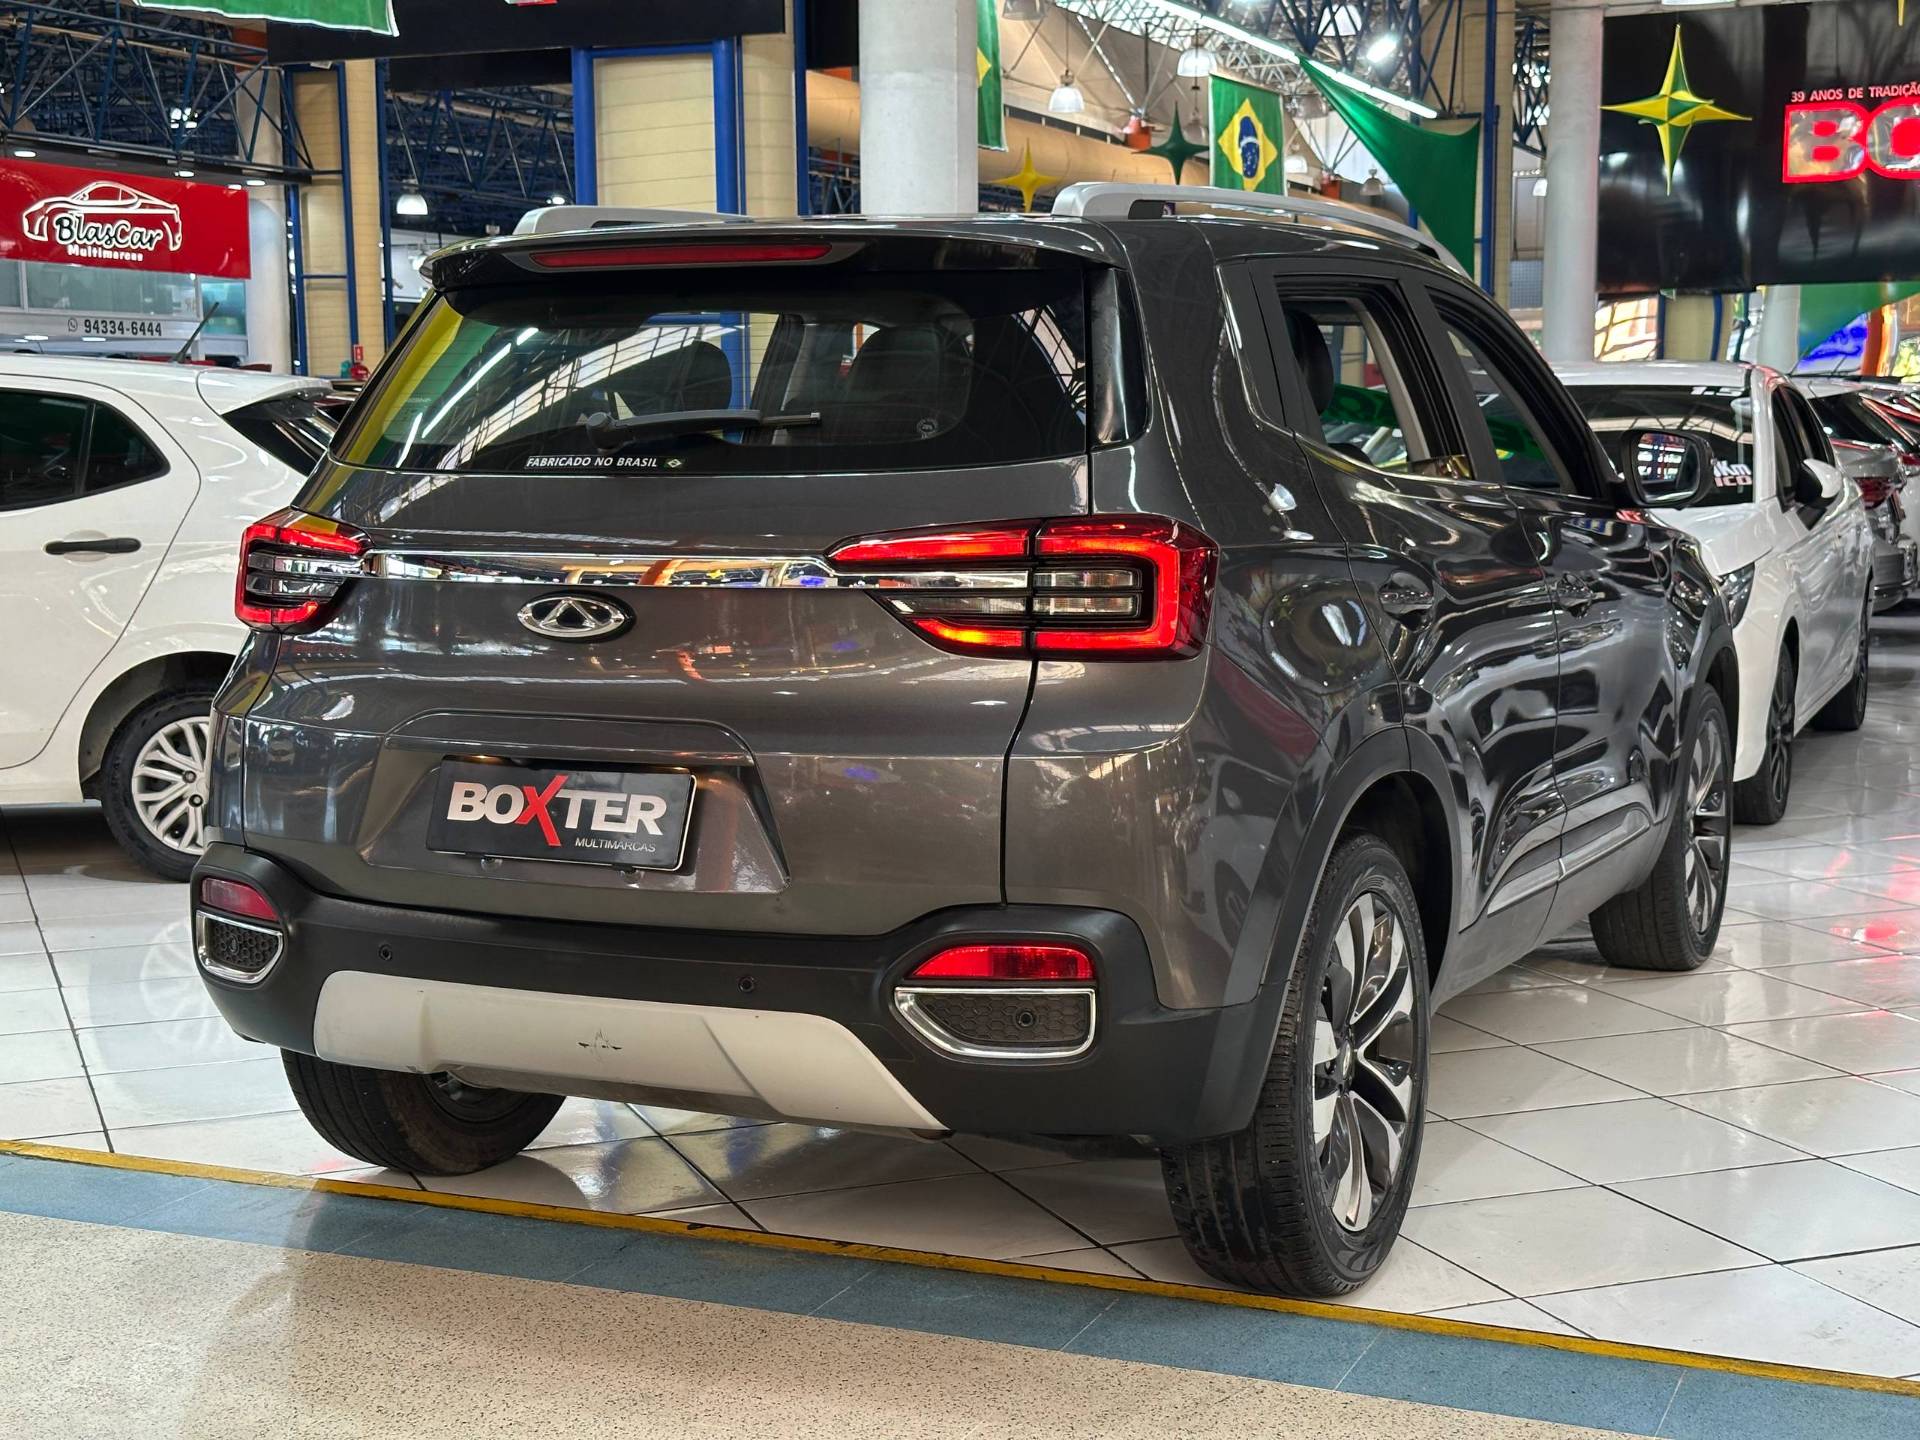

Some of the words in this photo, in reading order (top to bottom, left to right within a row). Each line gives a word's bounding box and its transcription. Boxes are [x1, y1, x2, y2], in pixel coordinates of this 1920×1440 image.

[1791, 91, 1805, 103] 39
[1809, 88, 1843, 102] ANOS
[1847, 87, 1864, 99] DE
[54, 213, 163, 250] BlasCar
[67, 244, 144, 262] Multimarcas
[84, 319, 162, 337] 94334-6444
[526, 457, 591, 467] FABRICADO
[594, 457, 613, 466] NO
[616, 458, 657, 467] BRASIL
[447, 774, 667, 847] BOXTER
[575, 837, 656, 853] MULTIMARCAS
